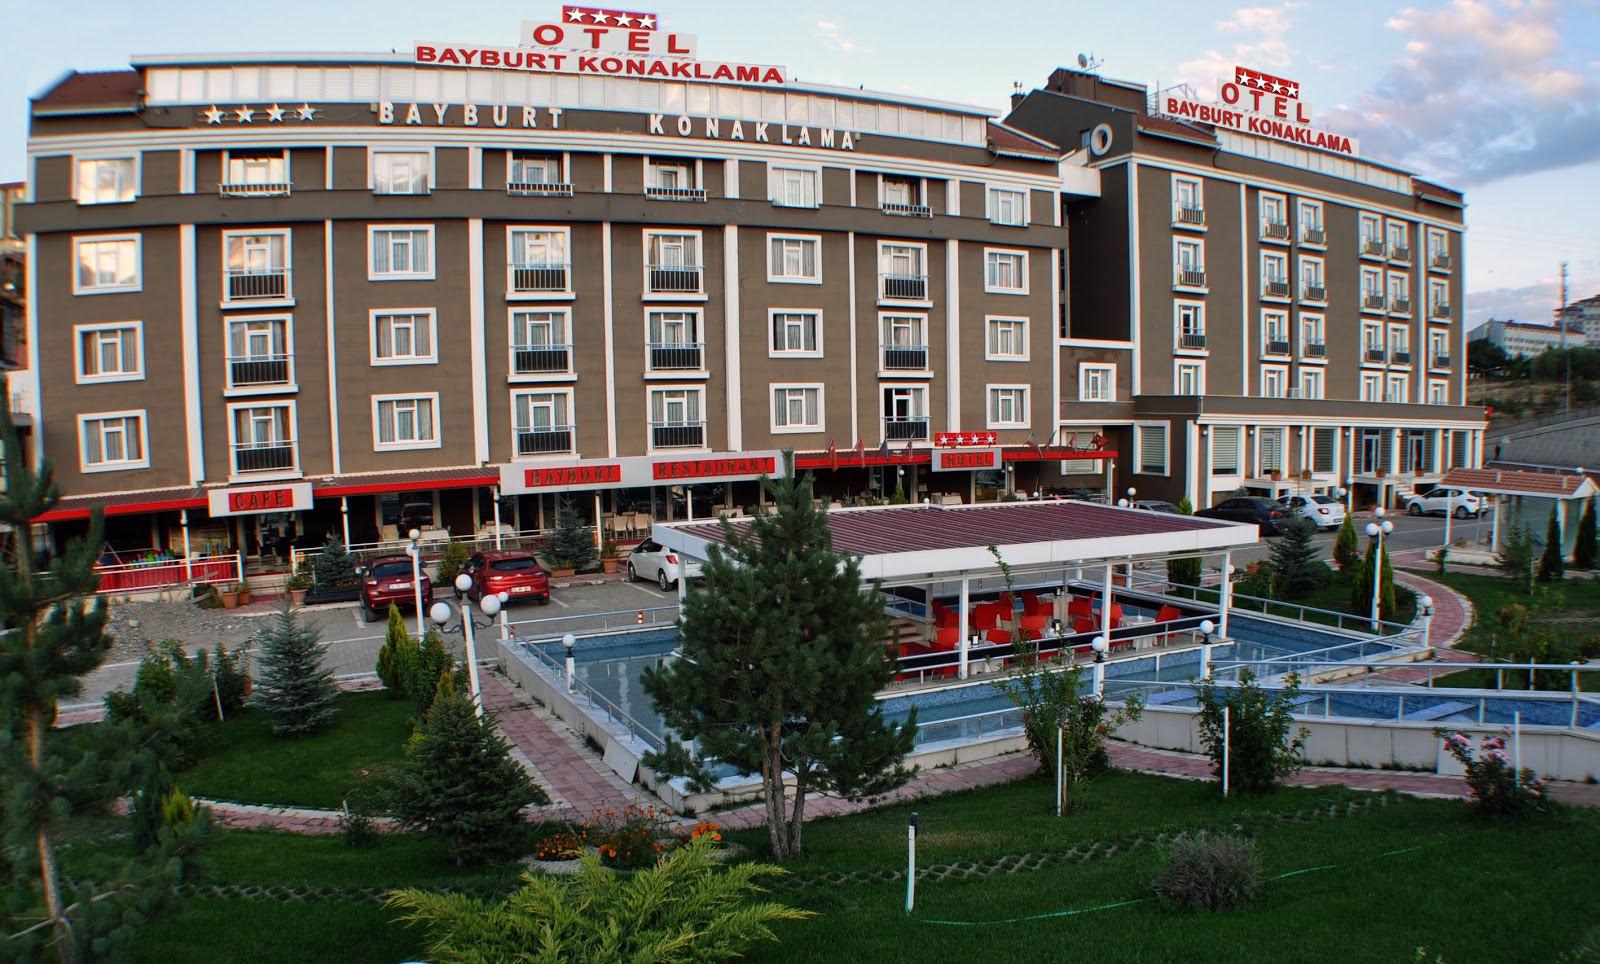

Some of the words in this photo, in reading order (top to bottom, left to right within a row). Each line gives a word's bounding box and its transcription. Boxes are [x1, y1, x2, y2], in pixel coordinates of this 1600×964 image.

[533, 24, 690, 54] OTEL
[416, 46, 567, 71] BAYBURT
[579, 56, 785, 84] KONAKLAMA
[1222, 82, 1310, 123] OTEL
[378, 102, 563, 129] BAYBURT
[649, 114, 854, 150] KONAKLAMA
[1167, 97, 1243, 128] BAYBURT
[1249, 116, 1352, 153] KONAKLAMA
[532, 465, 614, 486] BAYBURT
[659, 457, 769, 476] RESTAURANT
[946, 453, 991, 467] HOTEL
[235, 490, 286, 509] CAFE
